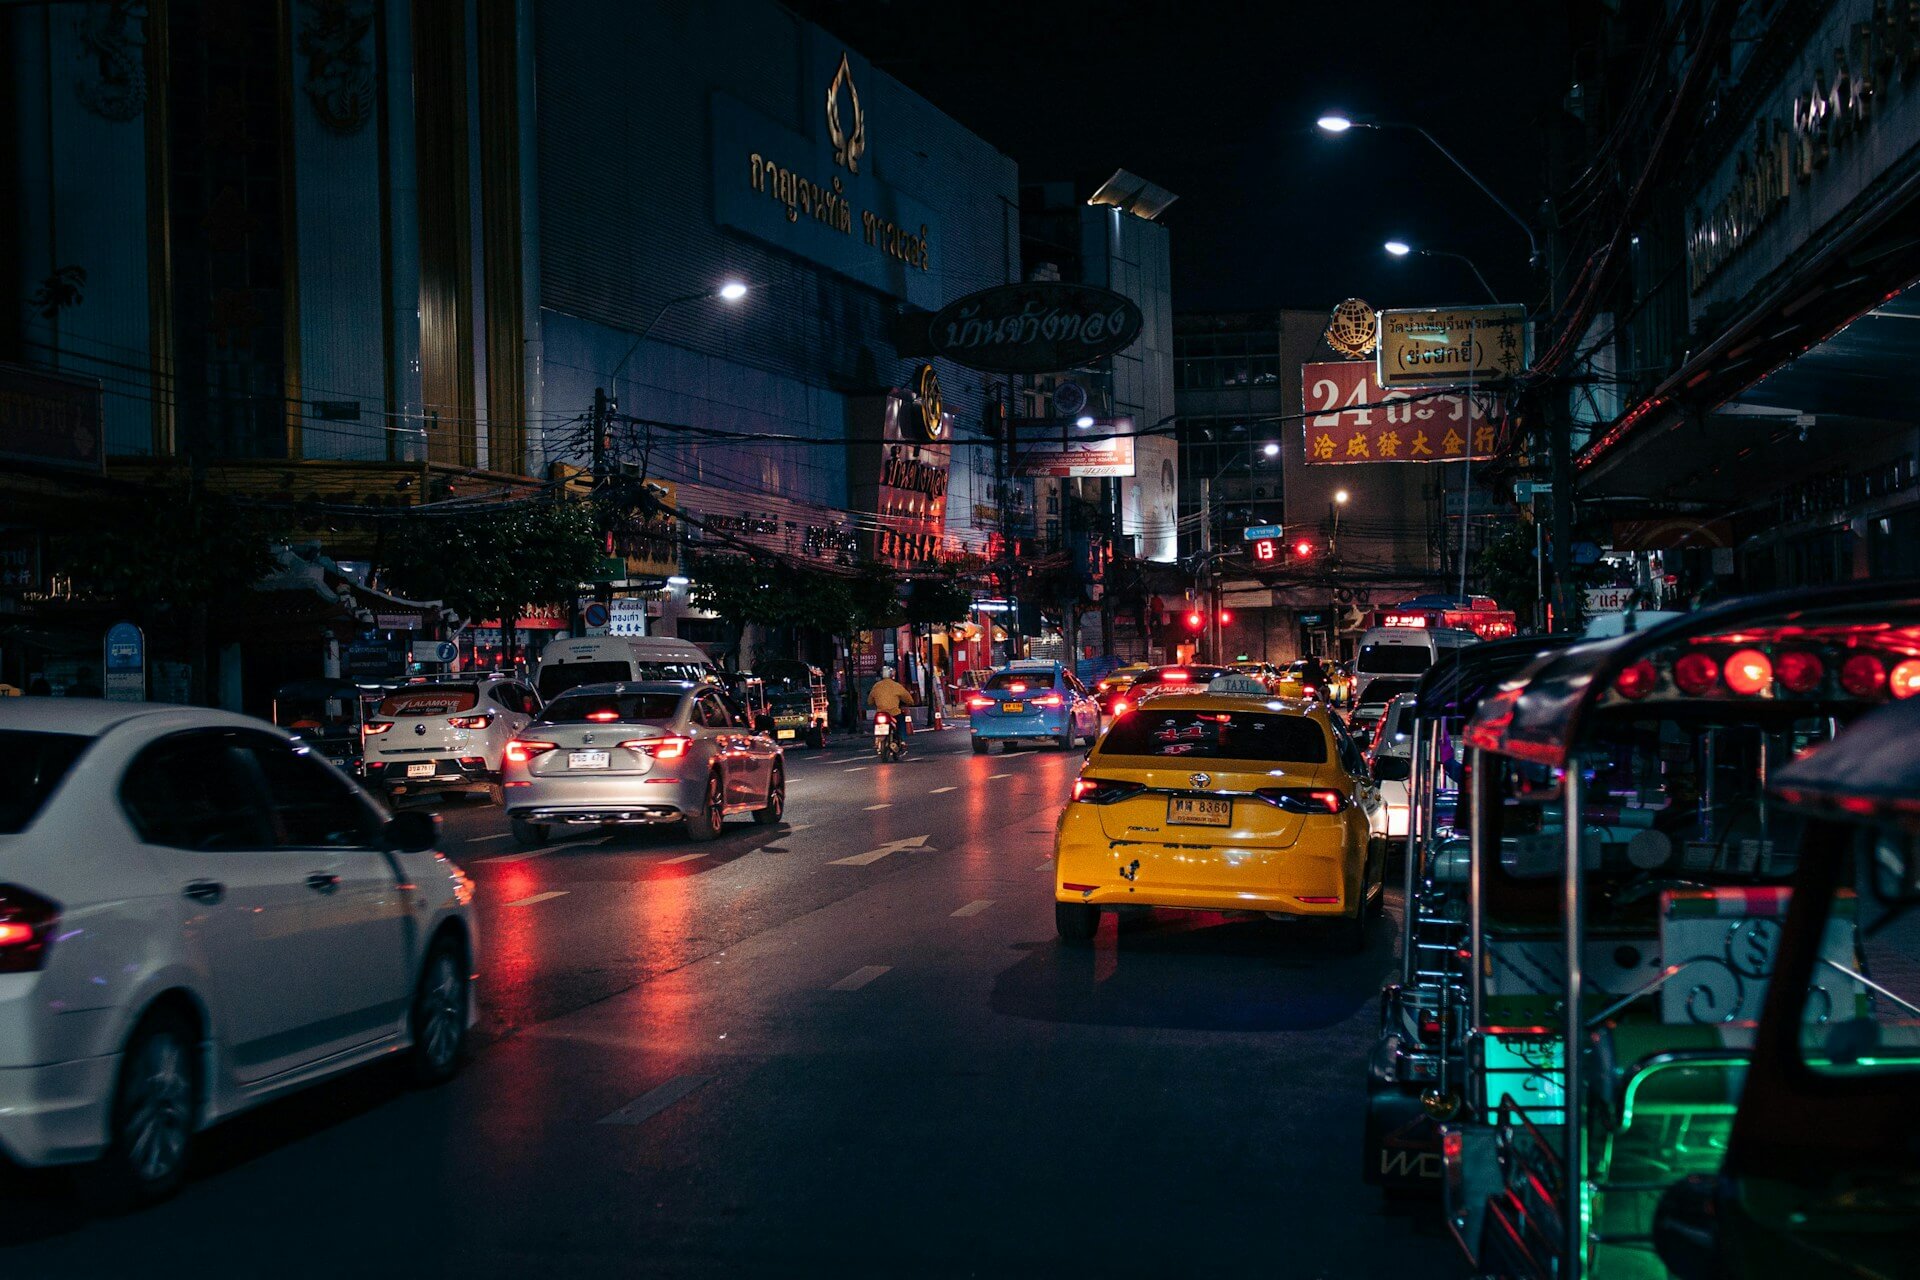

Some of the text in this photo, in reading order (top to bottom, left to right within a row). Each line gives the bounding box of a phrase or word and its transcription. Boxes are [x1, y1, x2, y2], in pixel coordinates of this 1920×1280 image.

[862, 209, 928, 270] ทาวเวอร์
[945, 301, 1126, 349] บ้านช่างทอง
[1312, 378, 1373, 427] 24
[1257, 541, 1273, 559] 13
[1226, 680, 1250, 691] TAXI
[408, 699, 460, 708] LALAMOVE
[1199, 801, 1228, 813] 8360
